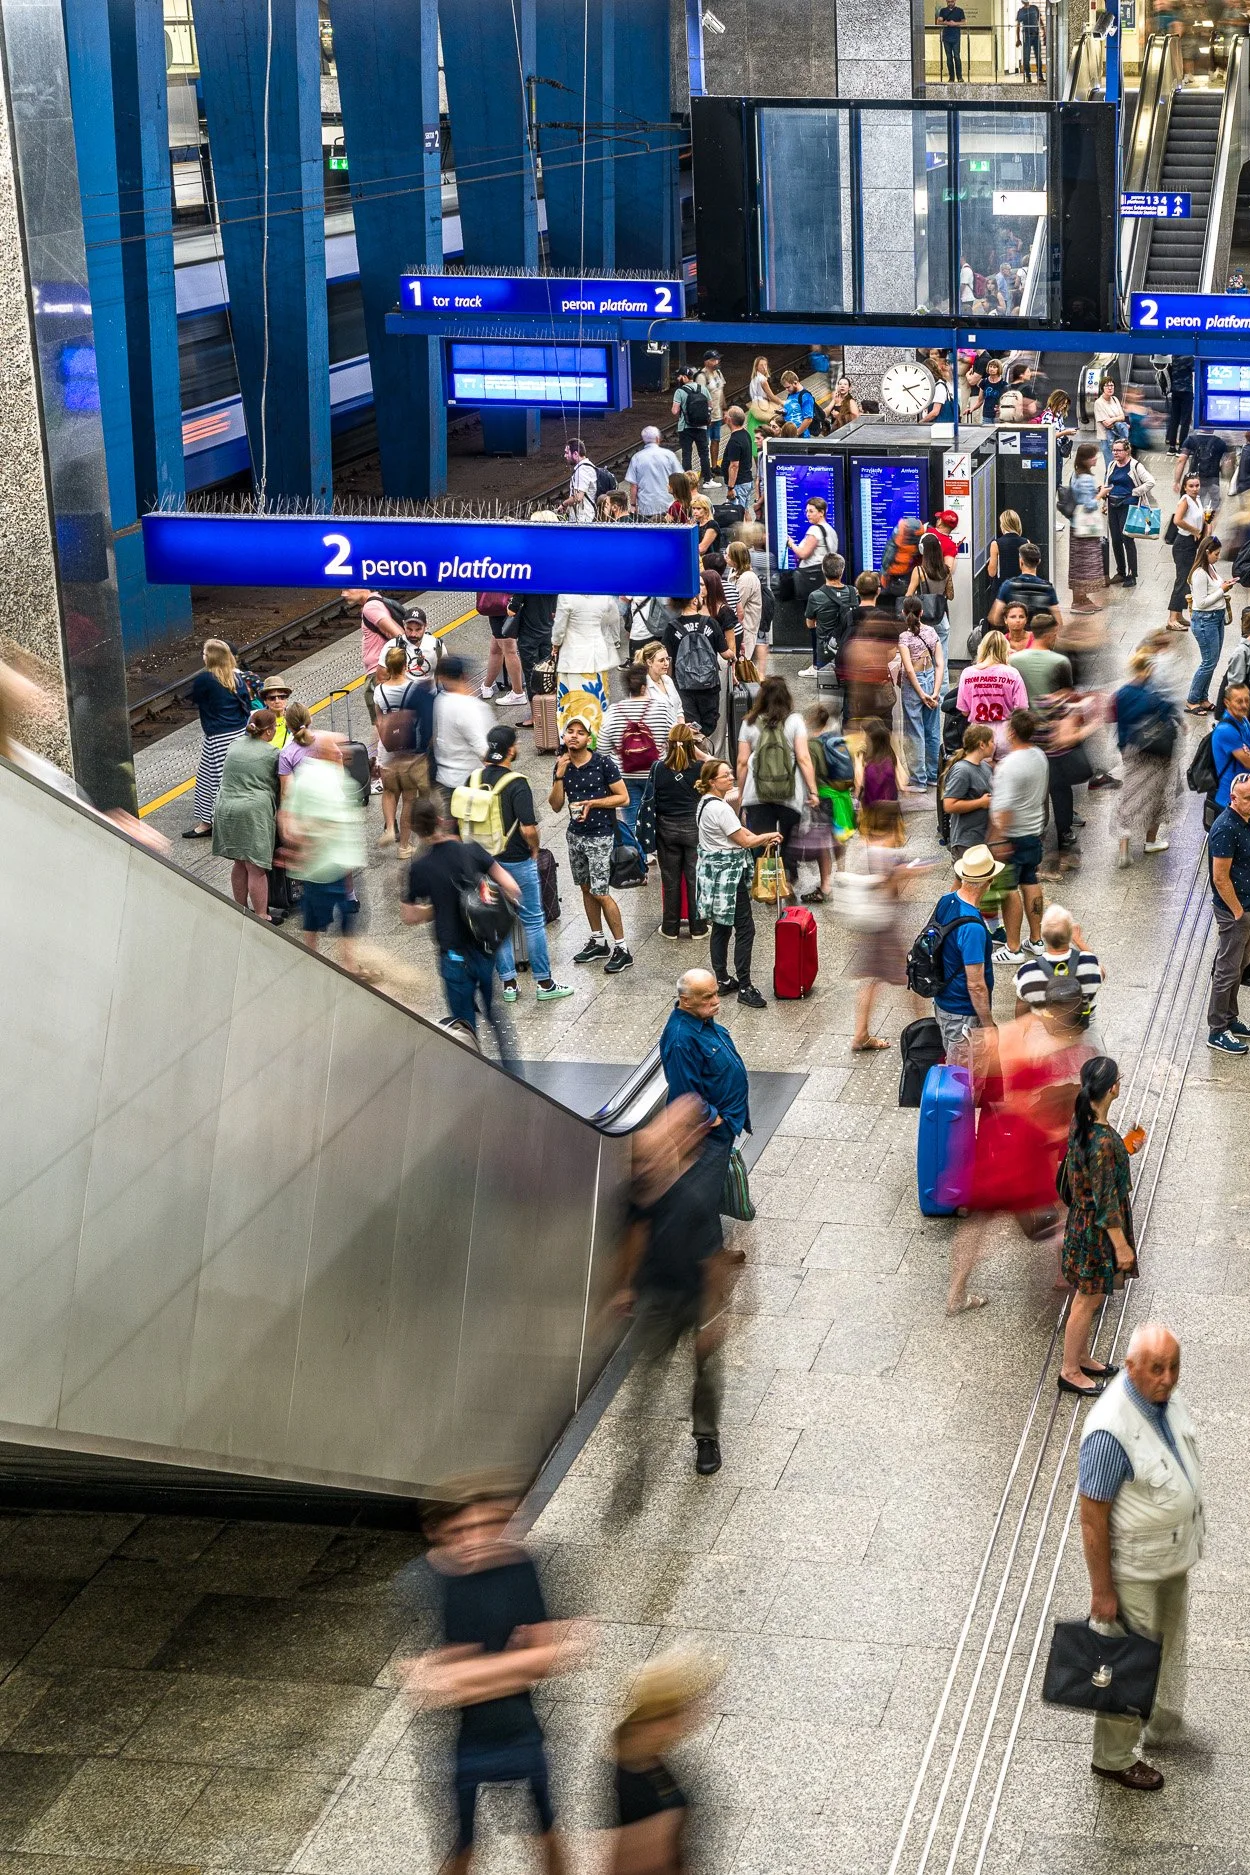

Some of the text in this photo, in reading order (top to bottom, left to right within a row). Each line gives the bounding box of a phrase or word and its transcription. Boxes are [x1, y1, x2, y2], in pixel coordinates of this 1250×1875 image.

[435, 130, 439, 148] 2
[1146, 195, 1151, 205] 1
[1153, 195, 1159, 205] 3
[1160, 195, 1167, 205] 4
[408, 280, 673, 313] 1 tor track peron platform 2
[1139, 299, 1158, 326] 2
[1165, 315, 1201, 329] peron
[322, 534, 532, 582] 2 peron platform
[965, 676, 979, 685] FROM
